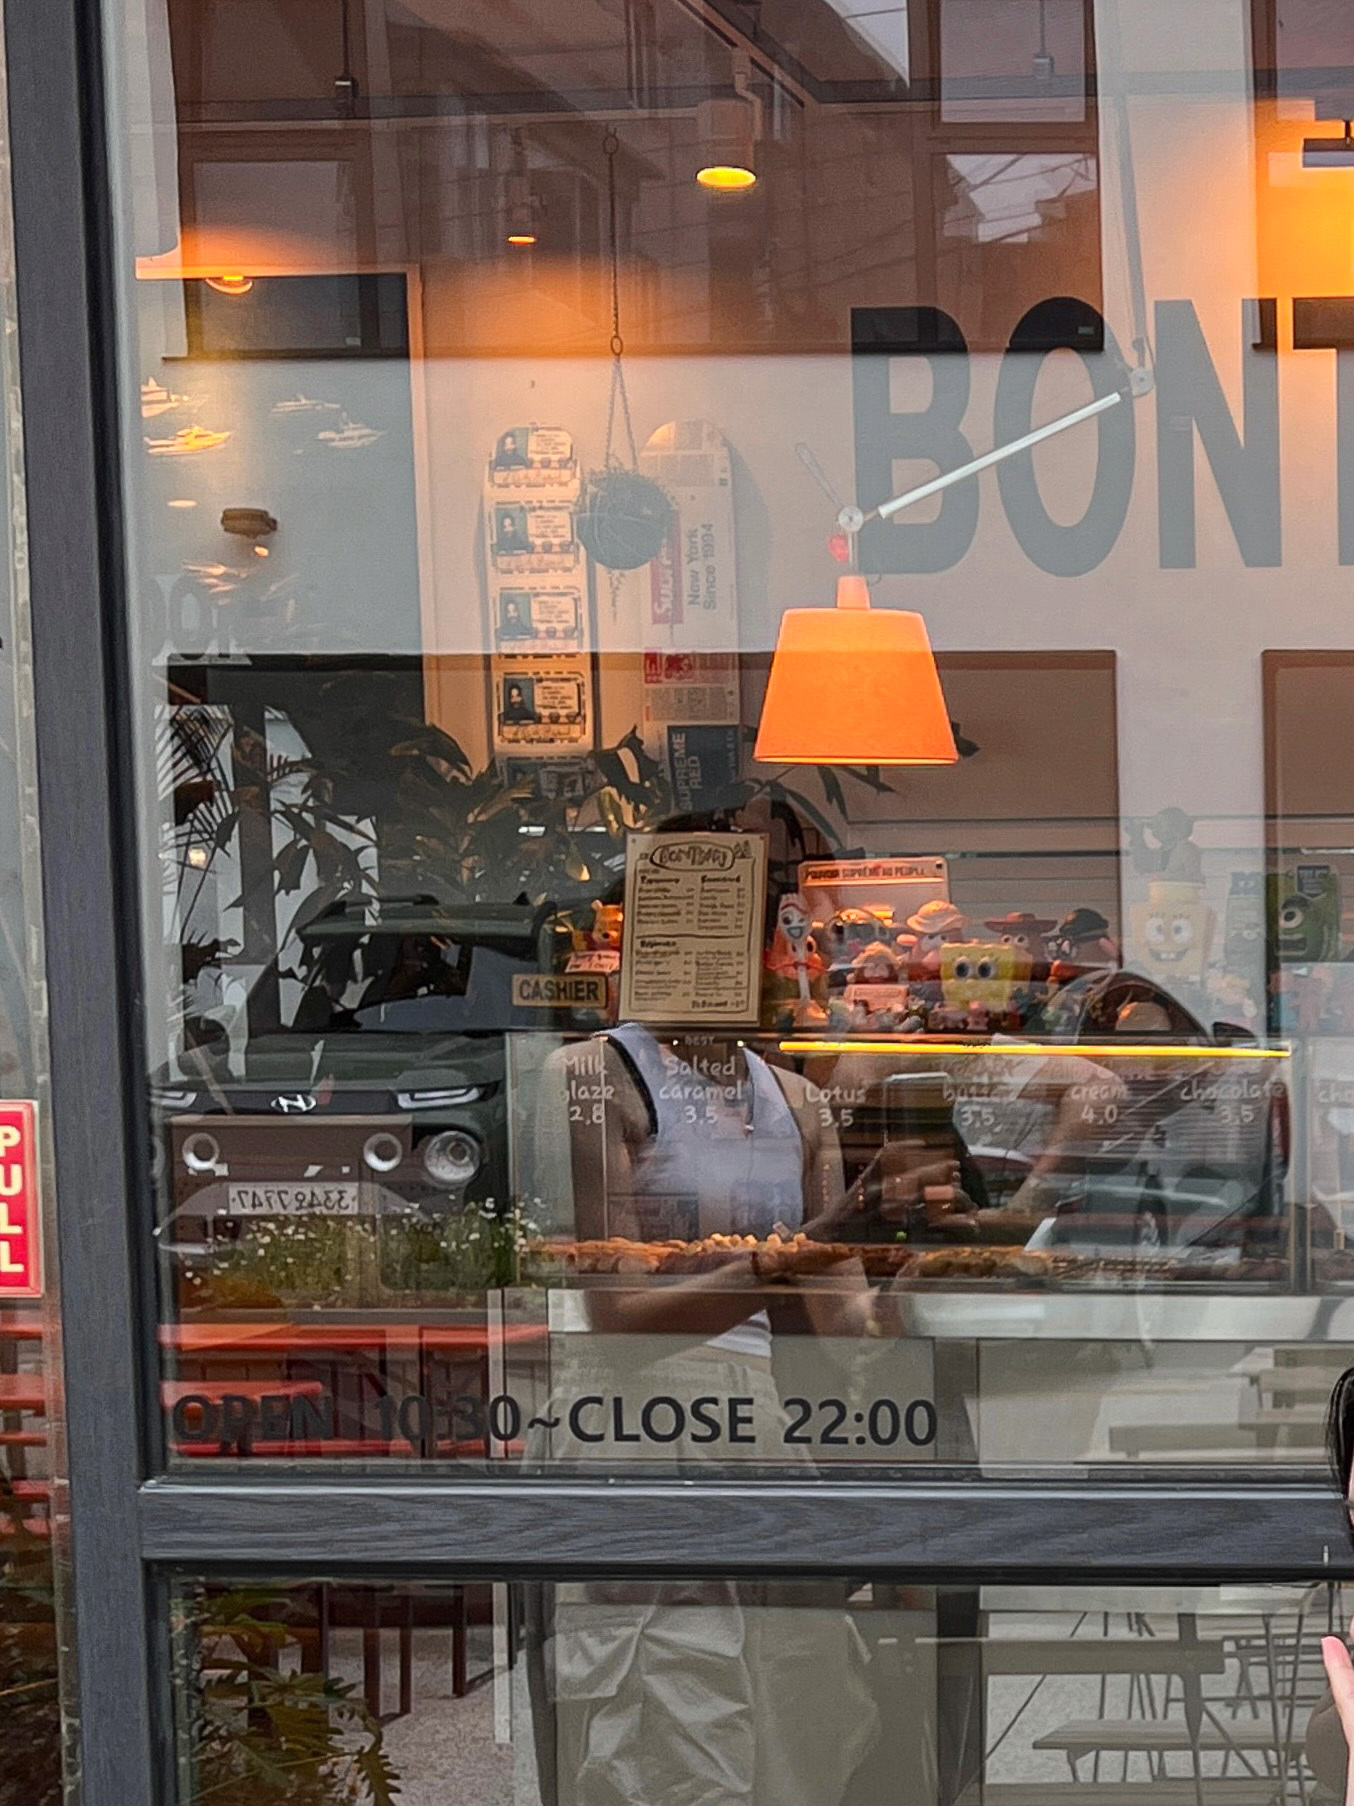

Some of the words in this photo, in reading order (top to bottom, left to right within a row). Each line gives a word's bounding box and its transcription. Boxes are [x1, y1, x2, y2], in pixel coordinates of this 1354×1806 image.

[673, 733, 692, 811] SUPREME
[688, 756, 702, 789] RED
[518, 978, 600, 1001] CASHIER
[563, 1056, 608, 1076] Milk
[664, 1055, 735, 1076] Salted
[660, 1080, 742, 1100] caramel
[805, 1084, 867, 1103] Lotus
[1071, 1083, 1127, 1100] cream
[1181, 1078, 1285, 1101] chocolate
[820, 1108, 854, 1128] 3.5
[1081, 1105, 1118, 1124] 4.0
[0, 1125, 25, 1273] PULL
[173, 1394, 333, 1441] OPEN
[783, 1398, 938, 1446] 22:00
